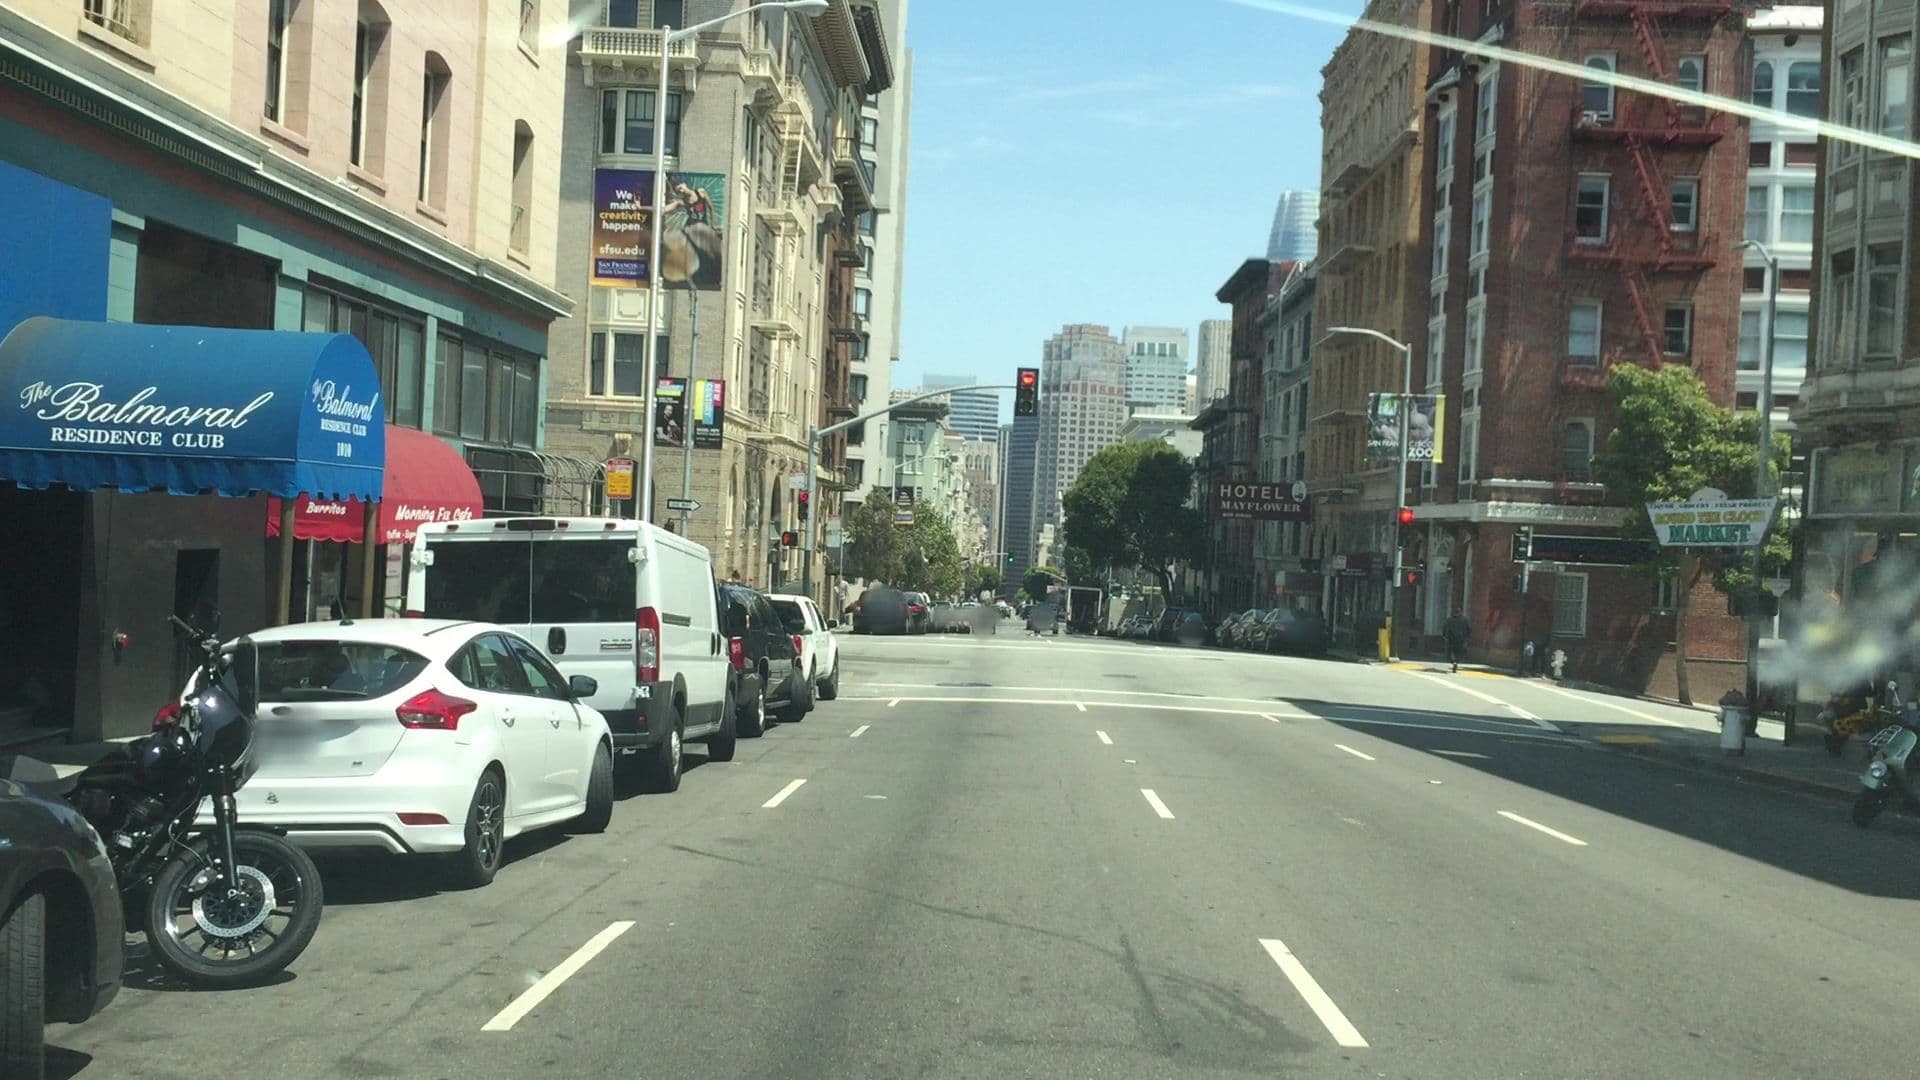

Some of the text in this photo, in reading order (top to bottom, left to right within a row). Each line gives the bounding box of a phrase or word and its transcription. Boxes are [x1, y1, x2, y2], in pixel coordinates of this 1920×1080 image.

[615, 190, 633, 200] We
[610, 201, 638, 210] make
[599, 211, 648, 223] creativity
[602, 220, 643, 233] happen.
[599, 244, 646, 256] sfsu.edu
[20, 381, 275, 429] The Balmoral
[316, 380, 379, 422] Balmoral
[352, 423, 367, 437] CLUB
[51, 426, 225, 449] RESIDENCE CLUB
[1408, 447, 1434, 459] ZOO
[1220, 484, 1285, 500] HOTEL
[305, 502, 347, 516] Burritos
[395, 504, 473, 522] Morning Fix Cafe
[1221, 500, 1301, 513] MAYFLOWER
[1668, 523, 1751, 543] MARKET
